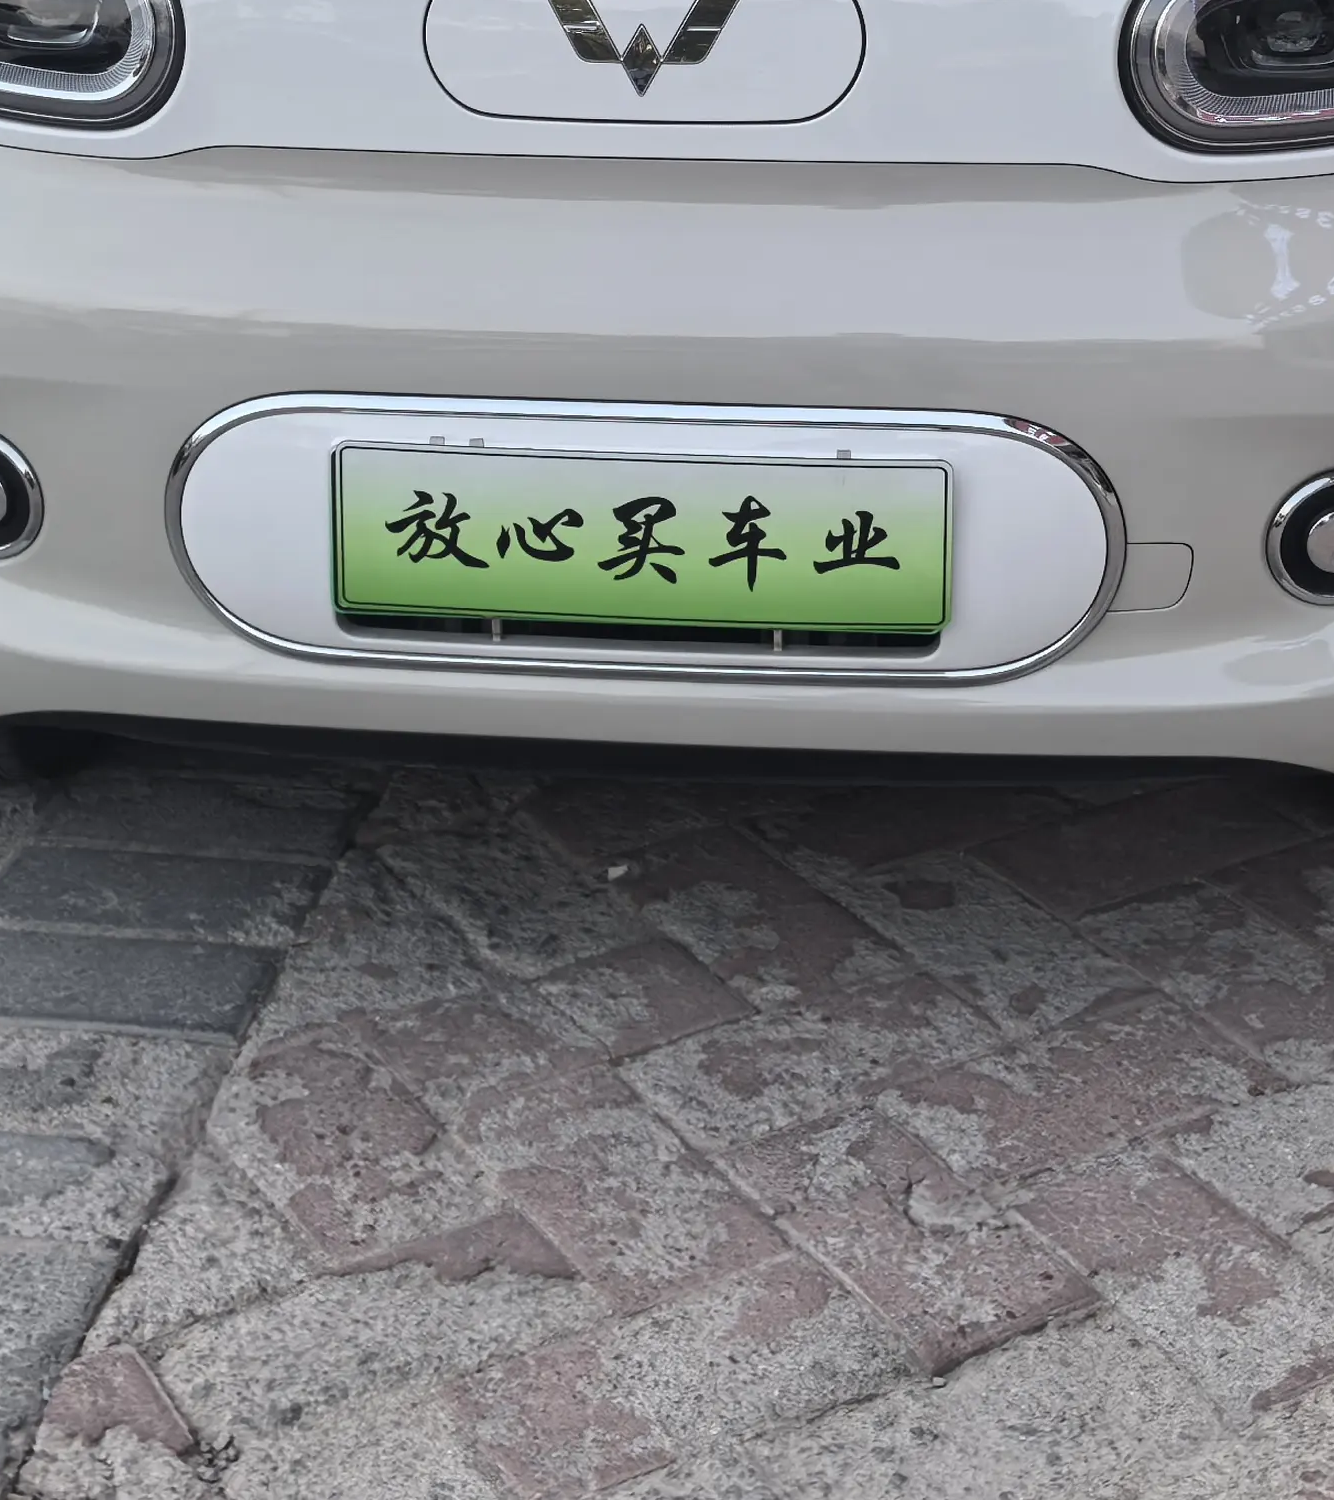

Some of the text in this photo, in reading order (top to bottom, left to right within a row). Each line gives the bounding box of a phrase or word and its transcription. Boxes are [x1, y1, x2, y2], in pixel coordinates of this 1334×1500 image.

[385, 489, 901, 592] 放心买车业
